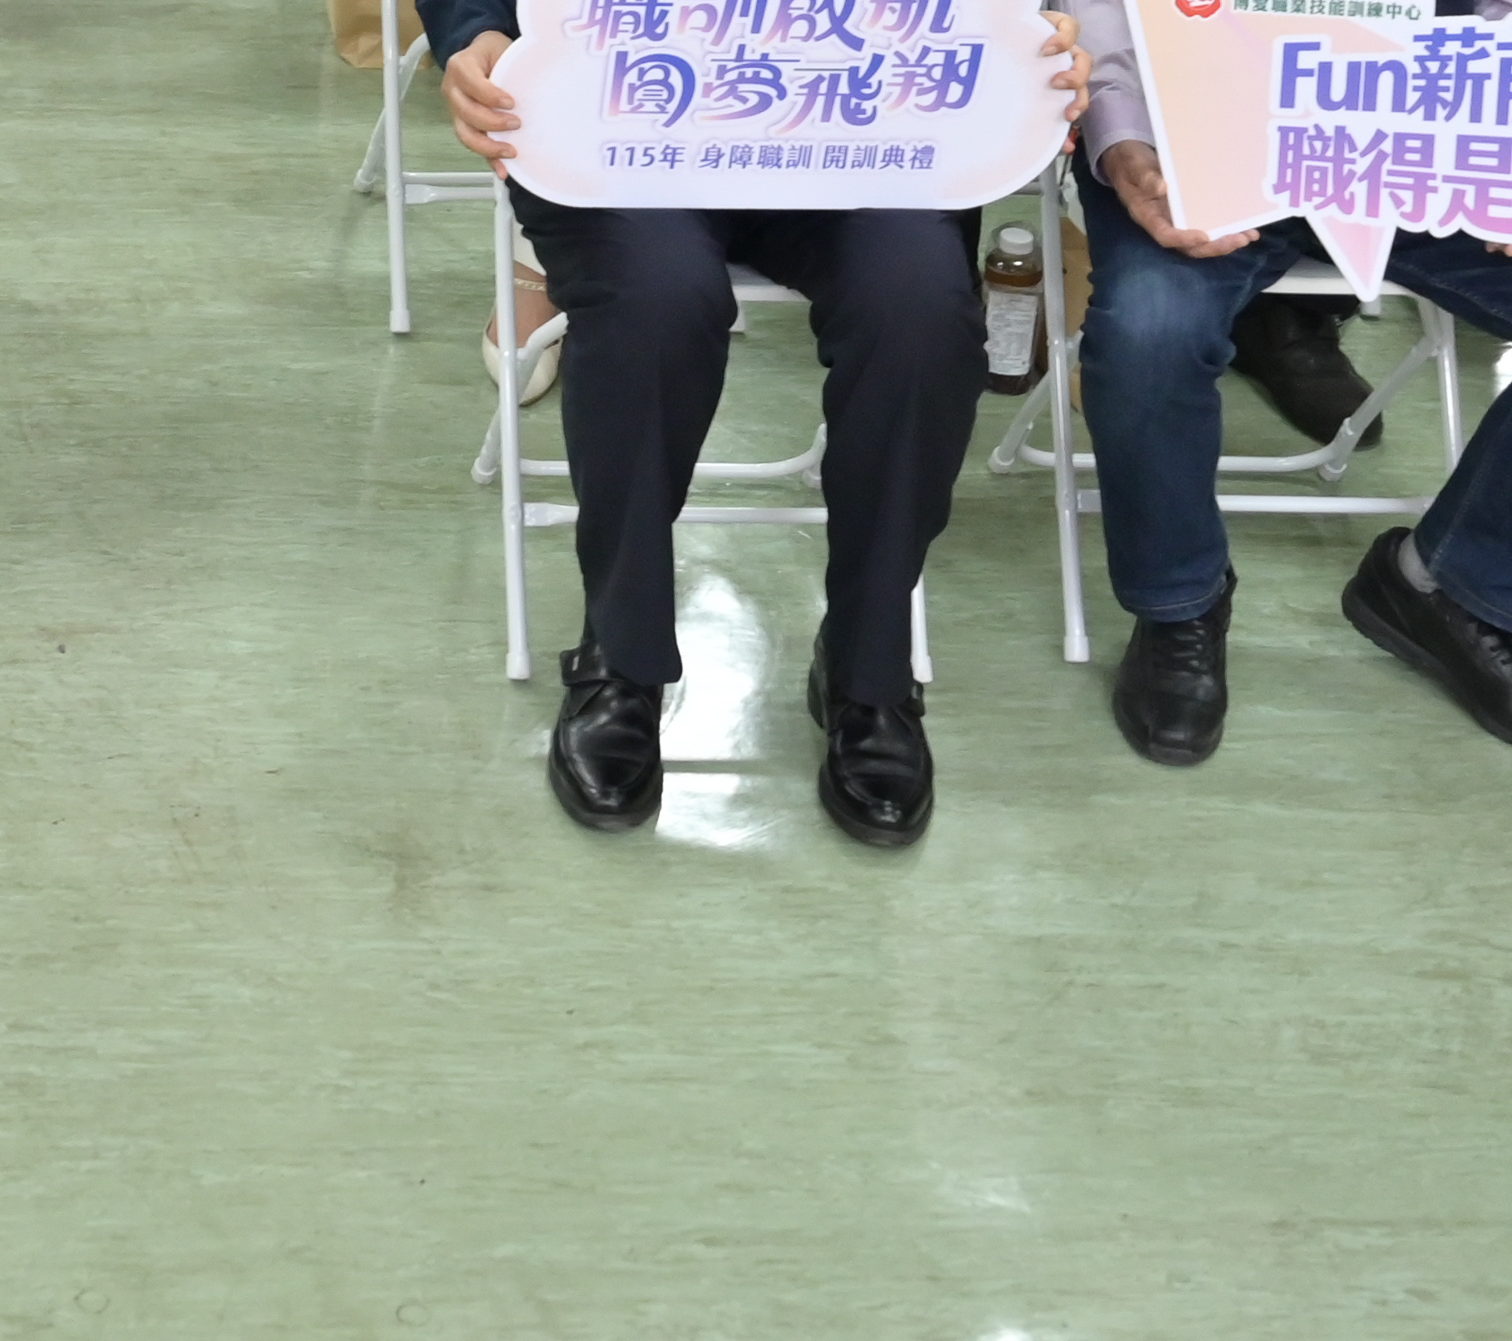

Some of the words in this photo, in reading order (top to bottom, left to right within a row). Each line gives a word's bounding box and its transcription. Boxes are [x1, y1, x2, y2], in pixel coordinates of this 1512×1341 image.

[605, 41, 985, 133] 圓夢飛翔
[603, 144, 685, 171] 115年
[699, 144, 813, 171] 身障職訓
[822, 144, 935, 171] 開訓典禮
